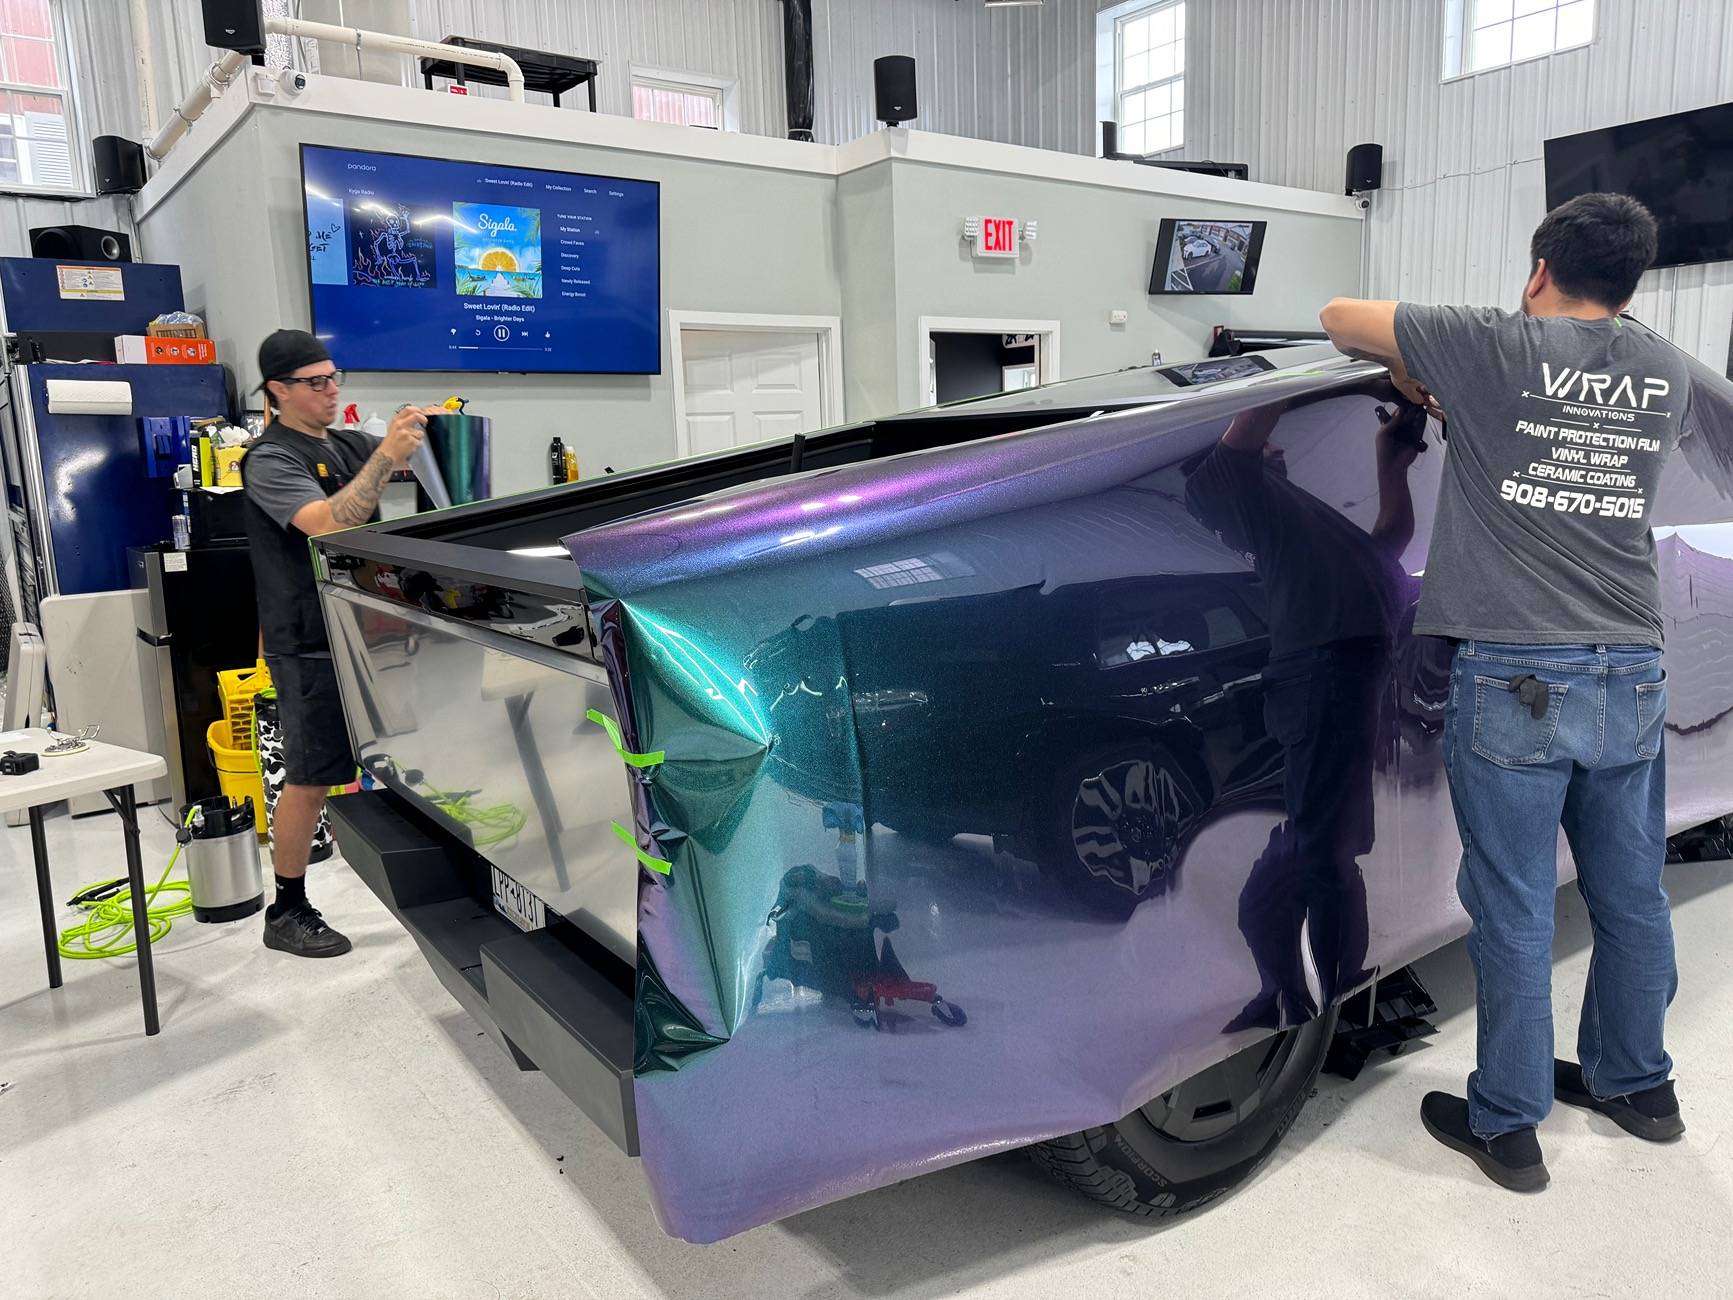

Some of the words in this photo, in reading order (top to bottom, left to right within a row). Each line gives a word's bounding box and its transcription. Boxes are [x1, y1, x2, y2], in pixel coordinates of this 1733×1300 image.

[347, 163, 377, 172] pandora
[984, 219, 1014, 252] EXIT
[463, 302, 482, 310] Sweet
[501, 304, 520, 312] (Radio
[1542, 362, 1670, 408] WRAP
[1562, 405, 1636, 422] INNOVATIONS
[1515, 420, 1558, 440] PAINT
[1558, 427, 1637, 450] PROTECTION
[1637, 438, 1660, 452] FILM
[1551, 447, 1587, 463] VINYL
[1590, 452, 1629, 467] WRAP
[1528, 462, 1585, 482] CERAMIC
[1586, 472, 1637, 487] COATING
[1500, 479, 1646, 519] 908-670-5015
